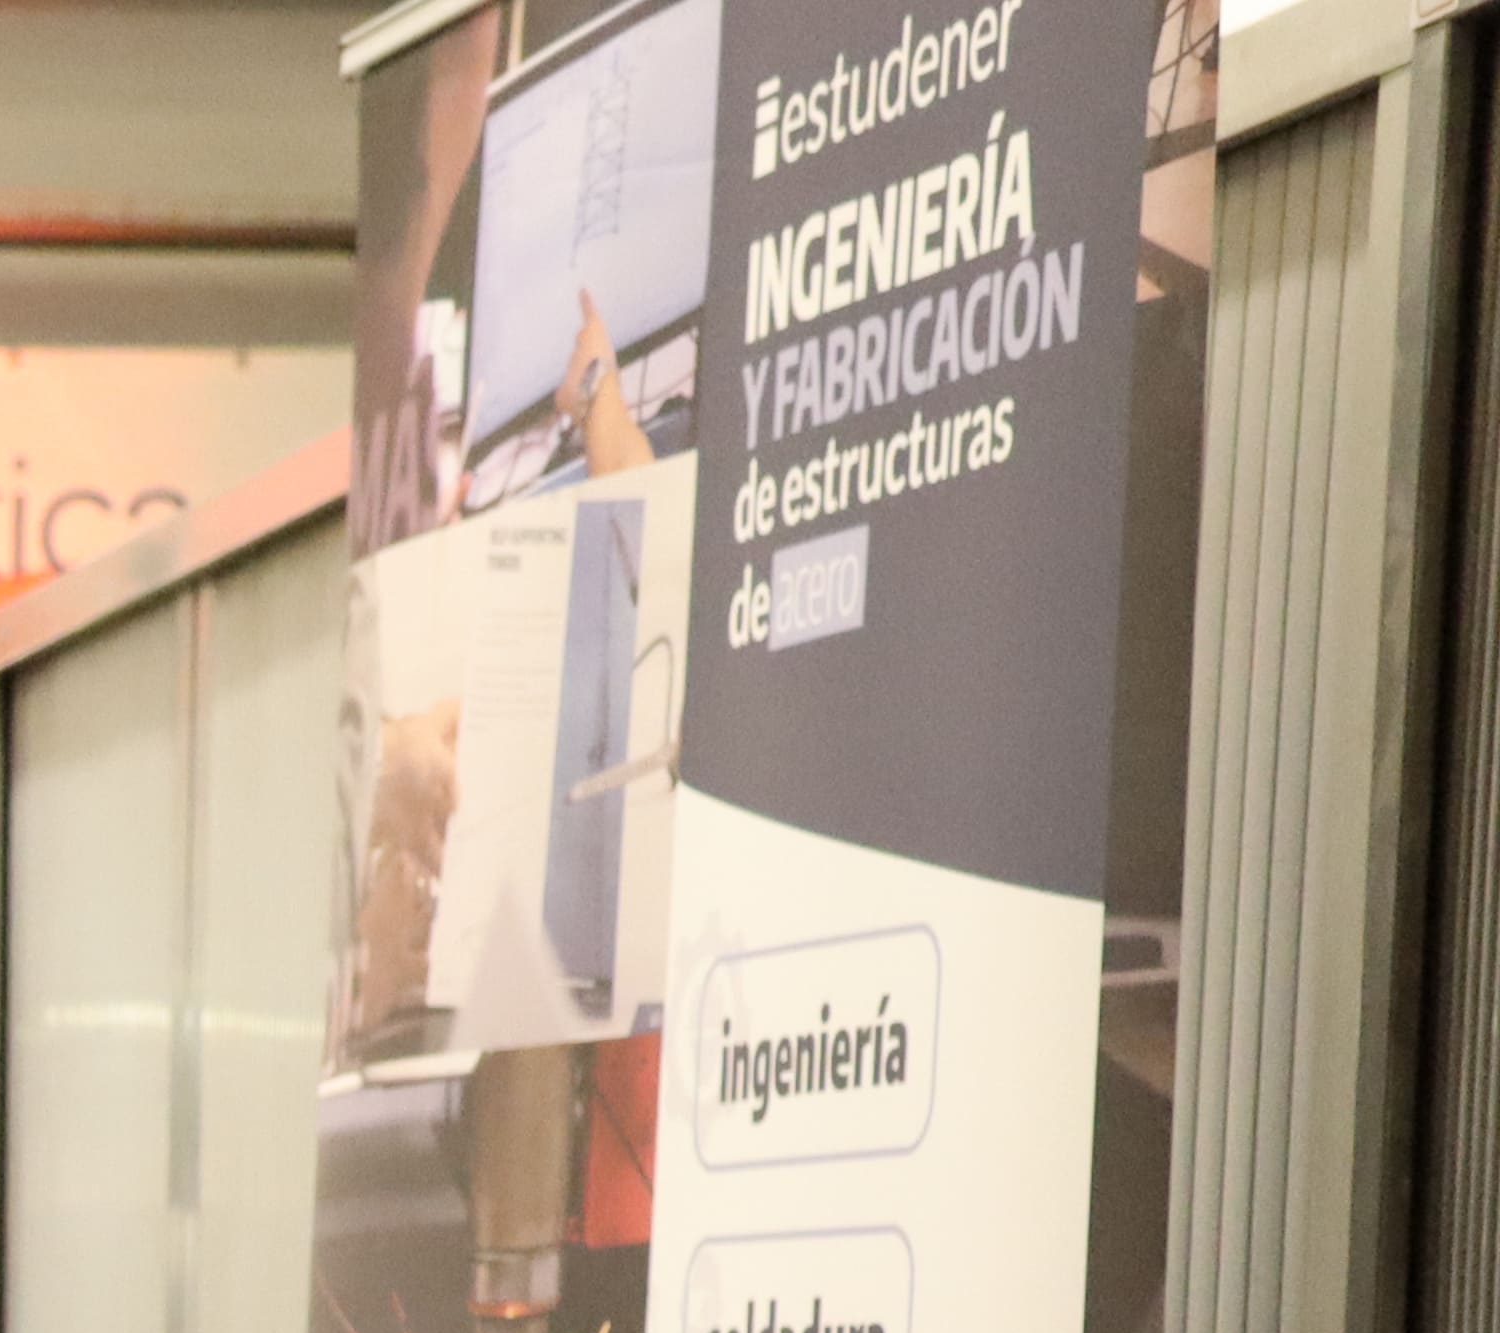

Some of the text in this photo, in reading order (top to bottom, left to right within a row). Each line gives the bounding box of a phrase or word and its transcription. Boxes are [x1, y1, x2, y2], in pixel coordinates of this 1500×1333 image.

[744, 110, 1035, 345] INGENIERÍA
[742, 232, 1085, 450] Y FABRICACIÓN
[733, 396, 1016, 544] de estructuras
[728, 562, 771, 650] de
[718, 994, 909, 1124] ingeniería
